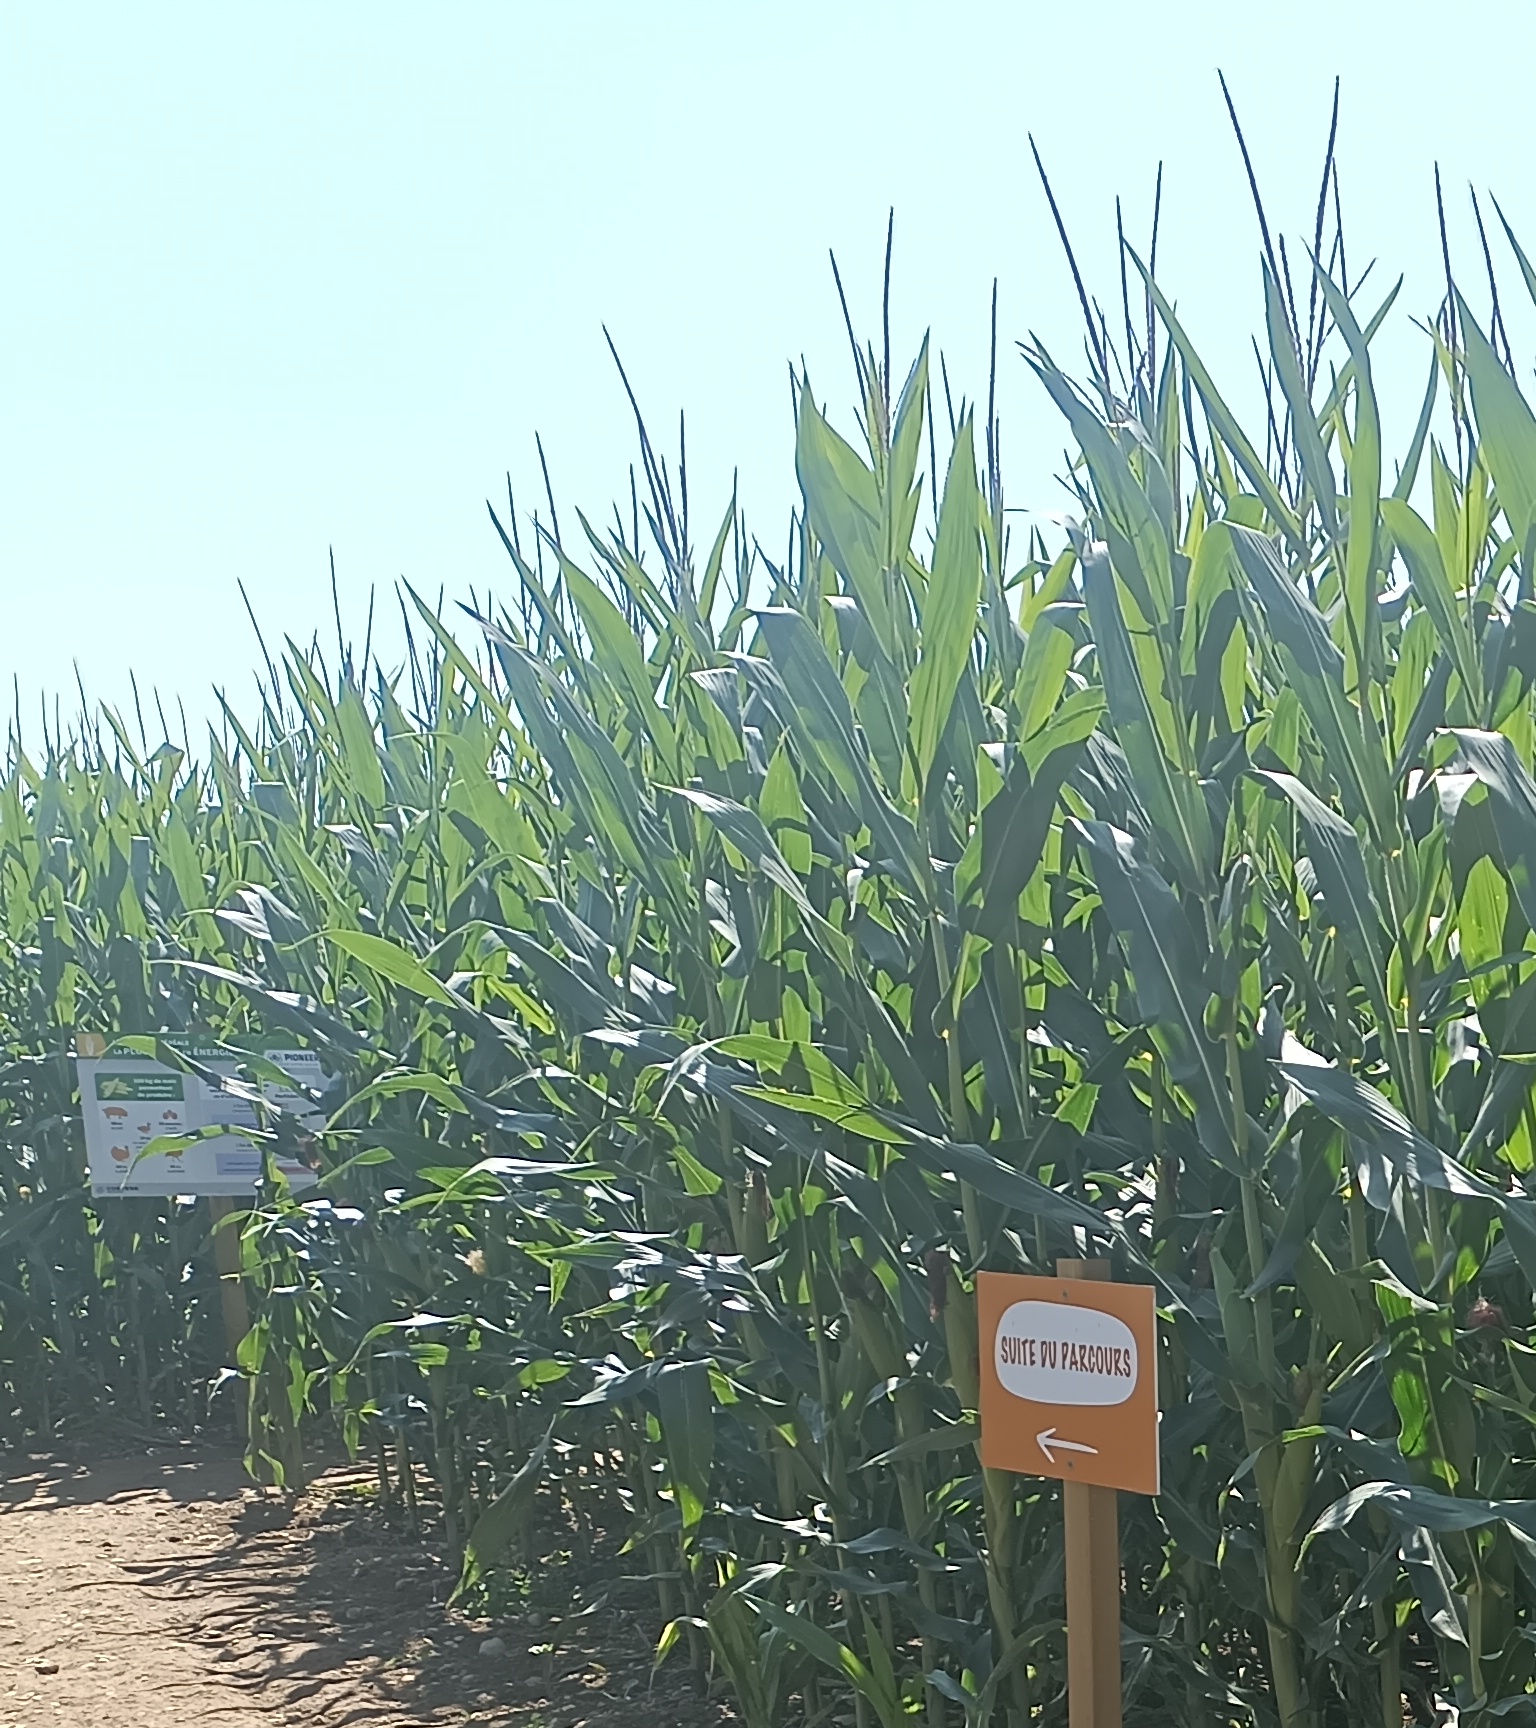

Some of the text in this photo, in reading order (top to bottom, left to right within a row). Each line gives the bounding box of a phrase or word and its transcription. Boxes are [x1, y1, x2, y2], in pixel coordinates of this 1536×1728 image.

[1001, 1335, 1132, 1378] SUITE DU PARCOURS
